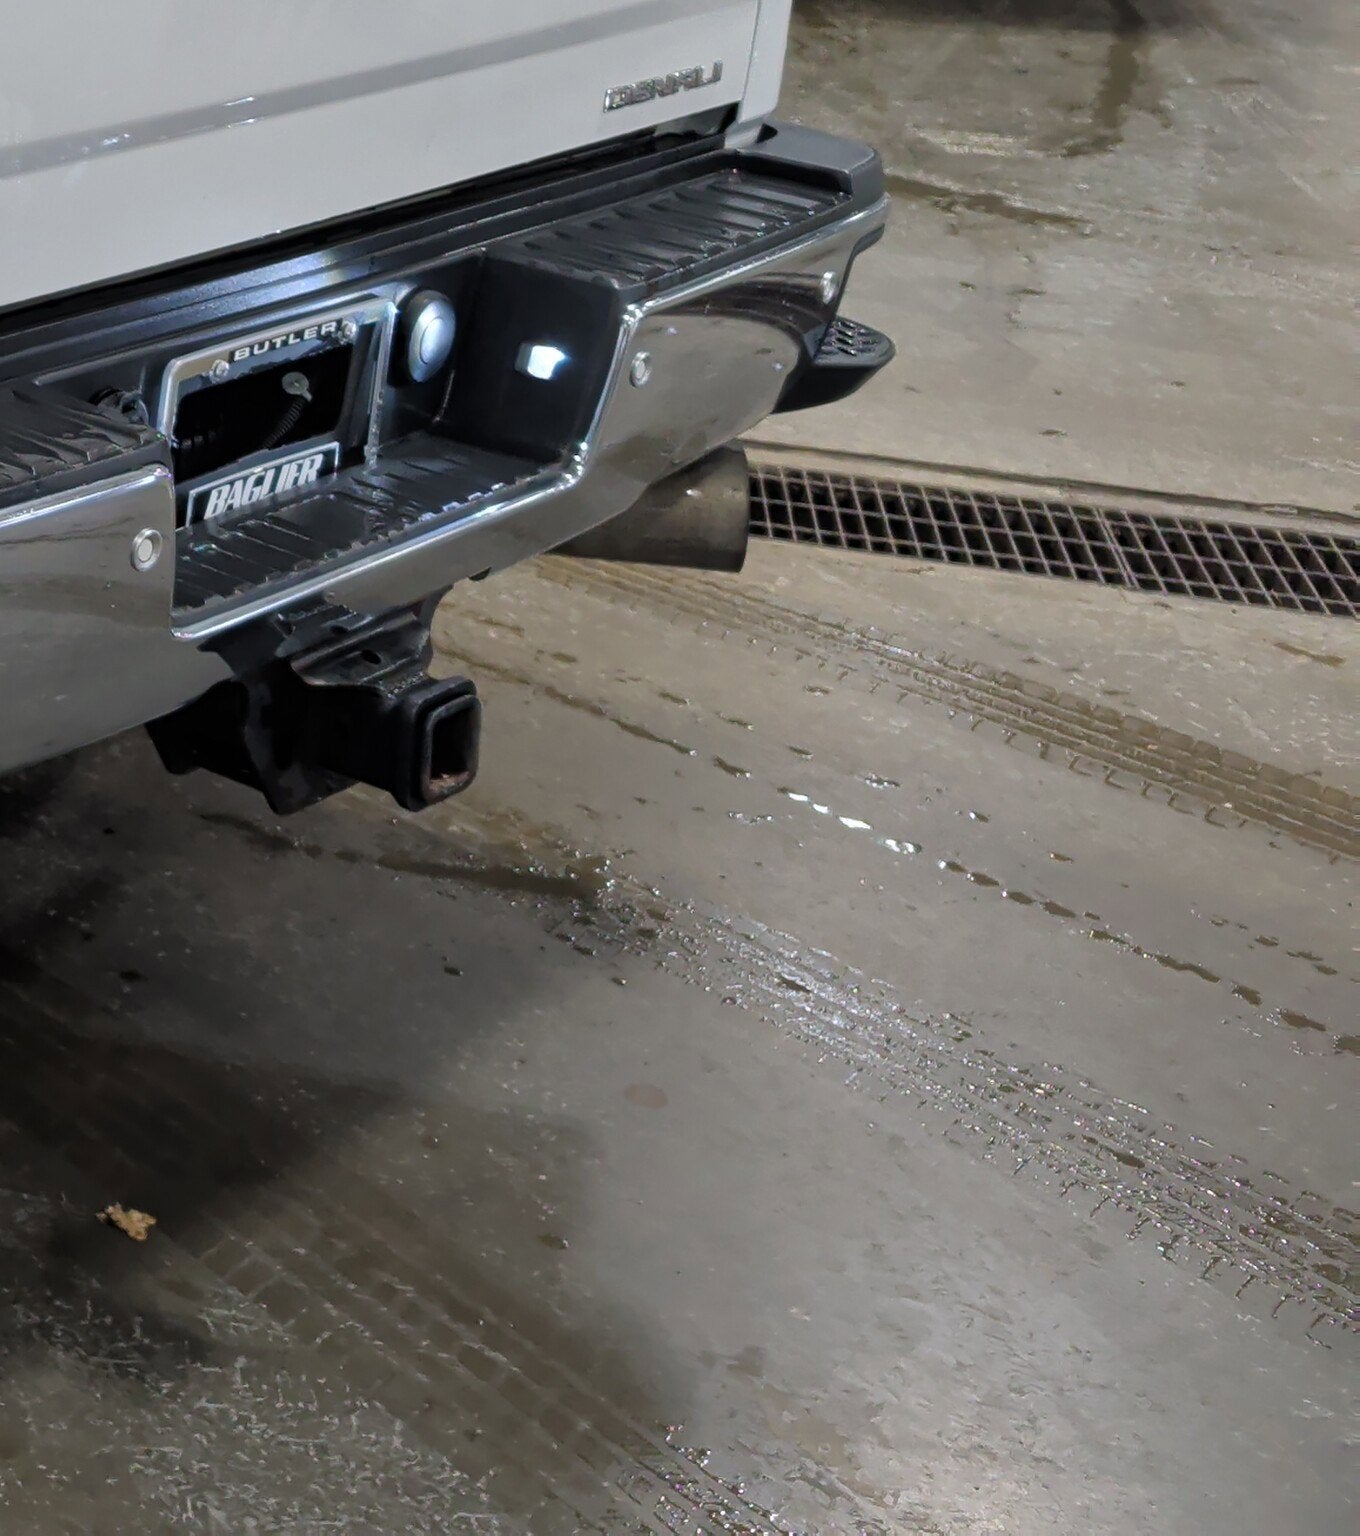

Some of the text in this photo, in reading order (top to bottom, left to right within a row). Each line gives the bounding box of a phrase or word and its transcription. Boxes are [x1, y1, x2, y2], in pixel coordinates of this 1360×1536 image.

[603, 58, 724, 113] DENALI
[233, 320, 338, 363] BUTLER
[203, 452, 325, 520] BAGLIER
